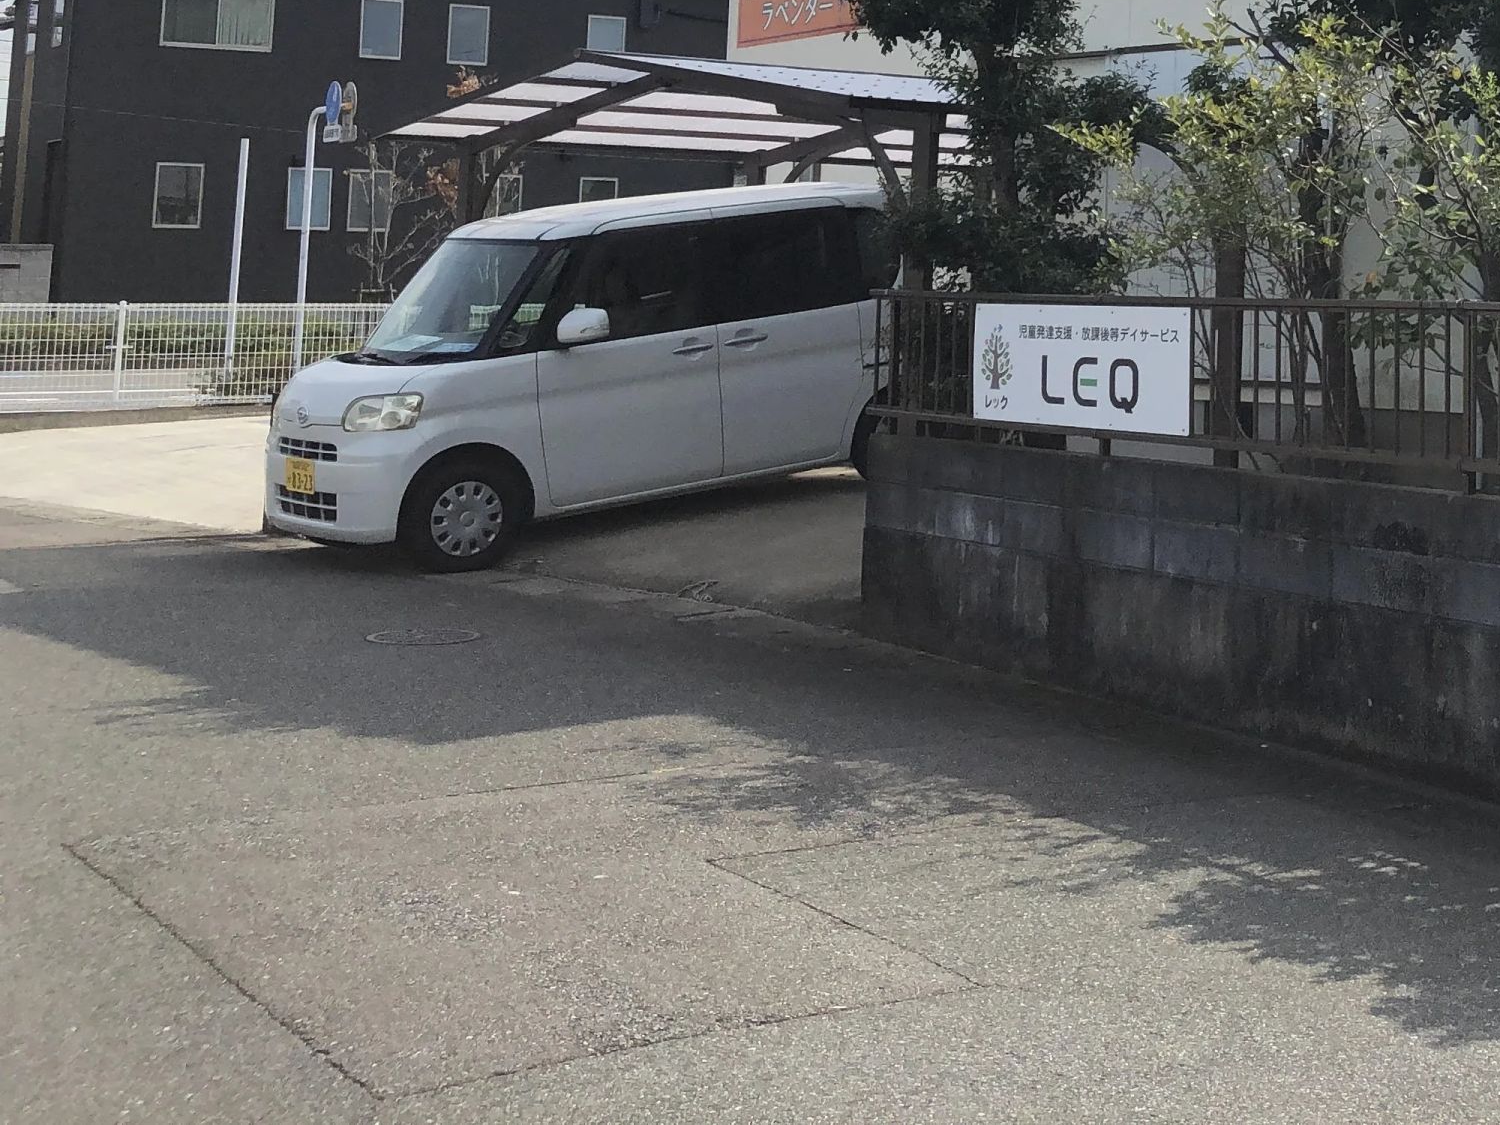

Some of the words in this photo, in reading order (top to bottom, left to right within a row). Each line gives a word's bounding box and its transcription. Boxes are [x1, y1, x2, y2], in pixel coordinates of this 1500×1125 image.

[984, 394, 1008, 410] レック
[1041, 354, 1139, 414] LEQ
